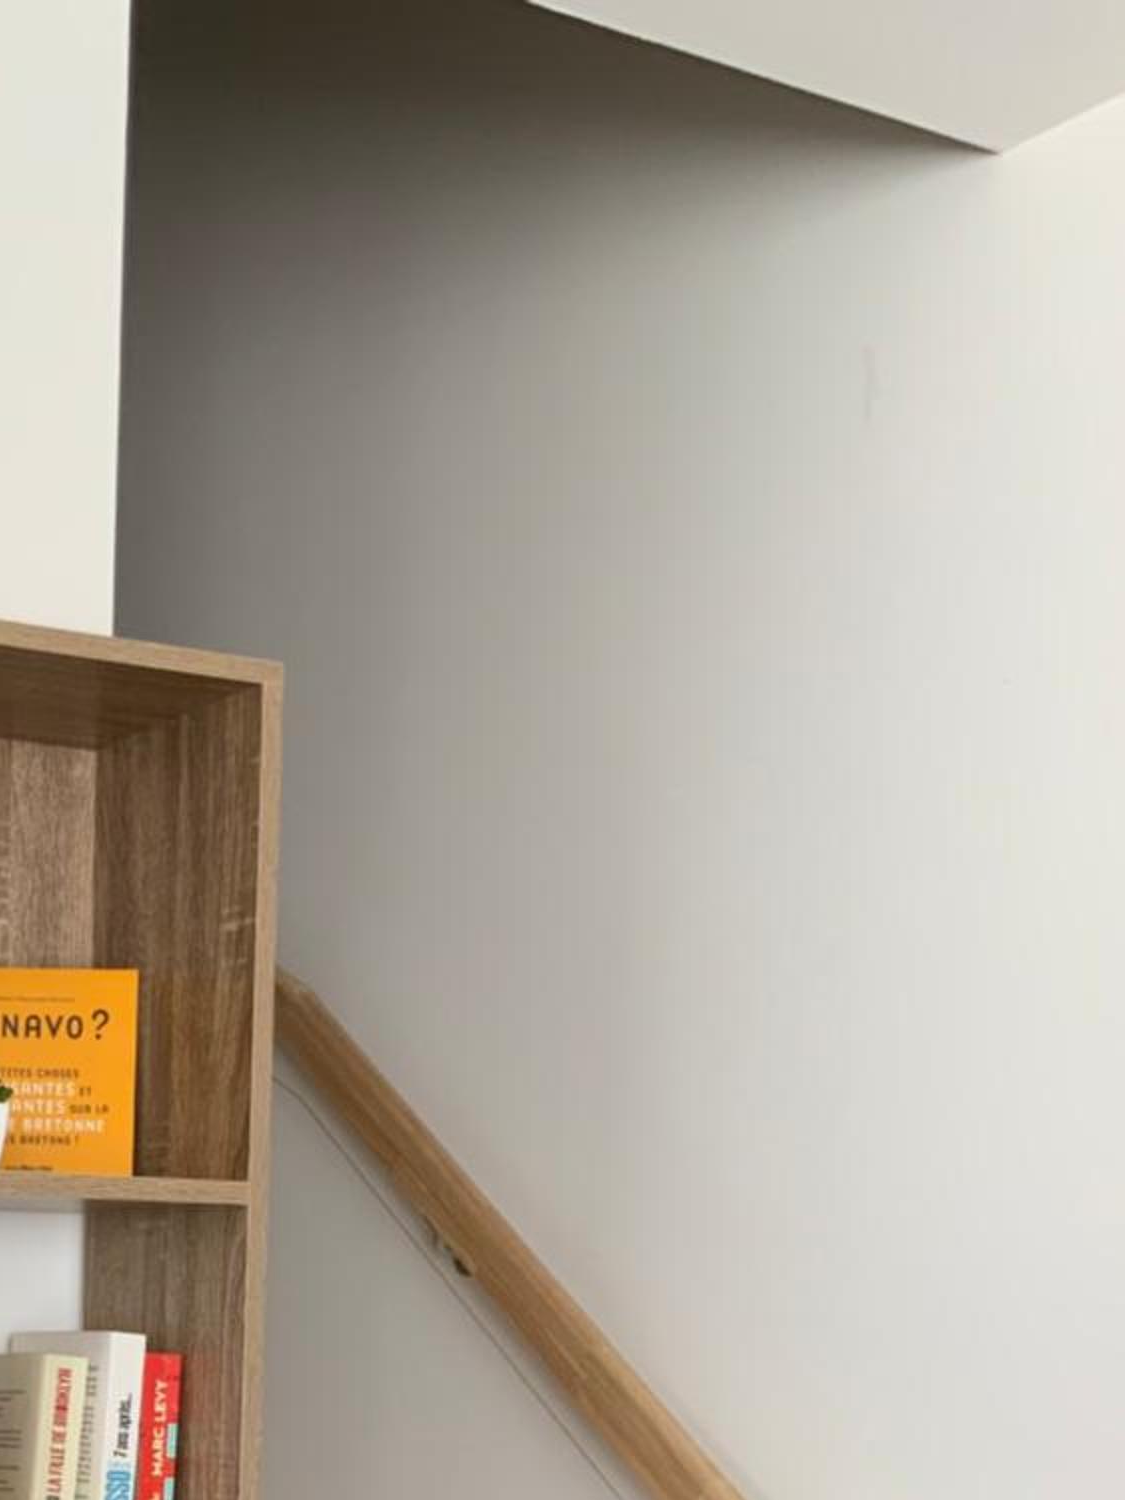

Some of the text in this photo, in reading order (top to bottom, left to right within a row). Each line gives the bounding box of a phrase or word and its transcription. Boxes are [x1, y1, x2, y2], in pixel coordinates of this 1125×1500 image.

[150, 1378, 168, 1476] MARC LEVY
[51, 1428, 65, 1445] DE
[116, 1432, 127, 1448] ans
[48, 1447, 64, 1474] FILLE
[113, 1449, 127, 1458] 7
[46, 1475, 61, 1493] LA
